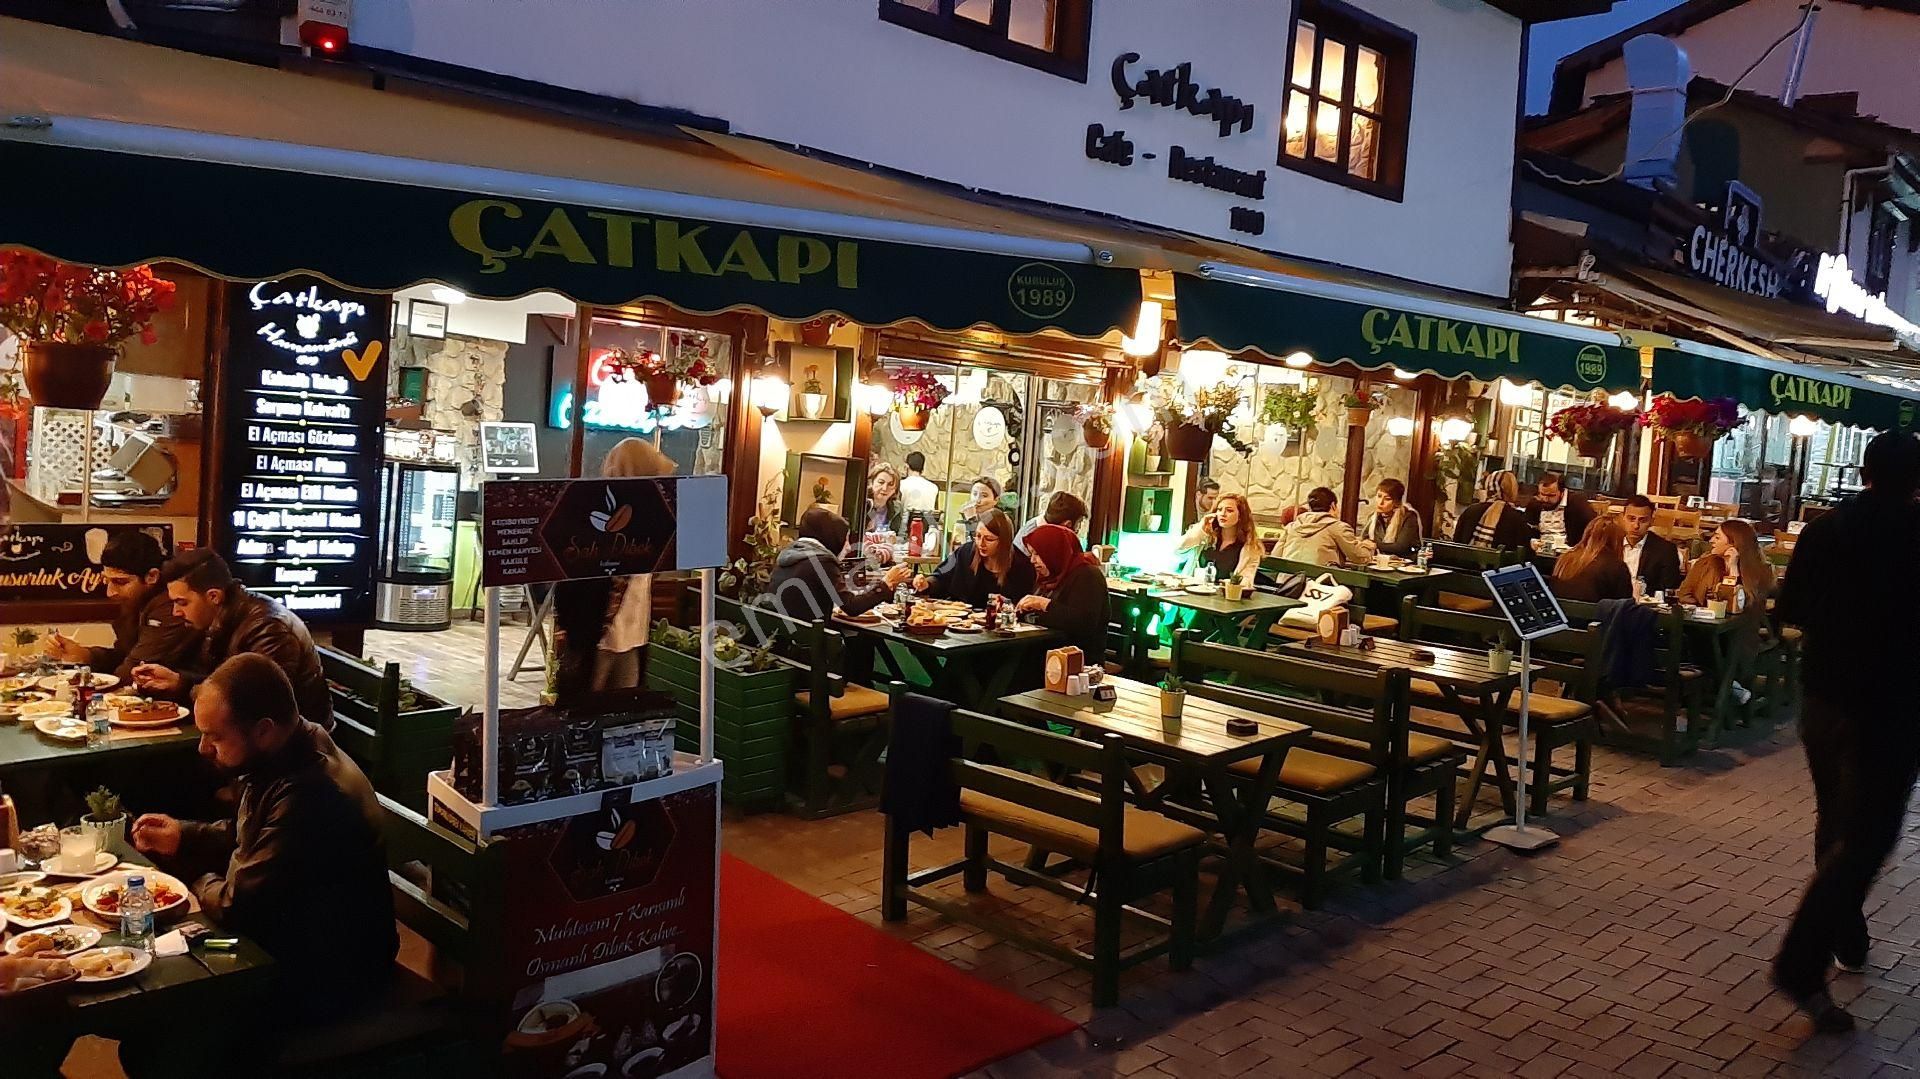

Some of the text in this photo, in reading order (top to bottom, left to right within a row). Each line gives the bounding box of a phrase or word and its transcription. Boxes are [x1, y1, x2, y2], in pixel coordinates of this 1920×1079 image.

[448, 199, 858, 289] ÇATKAPI
[249, 280, 365, 324] Çatkapı
[1017, 288, 1066, 307] 1989
[1361, 309, 1520, 363] ÇATKAPI
[1770, 373, 1853, 410] ÇATKAPI
[263, 427, 304, 444] Açması
[0, 568, 67, 590] usurluk
